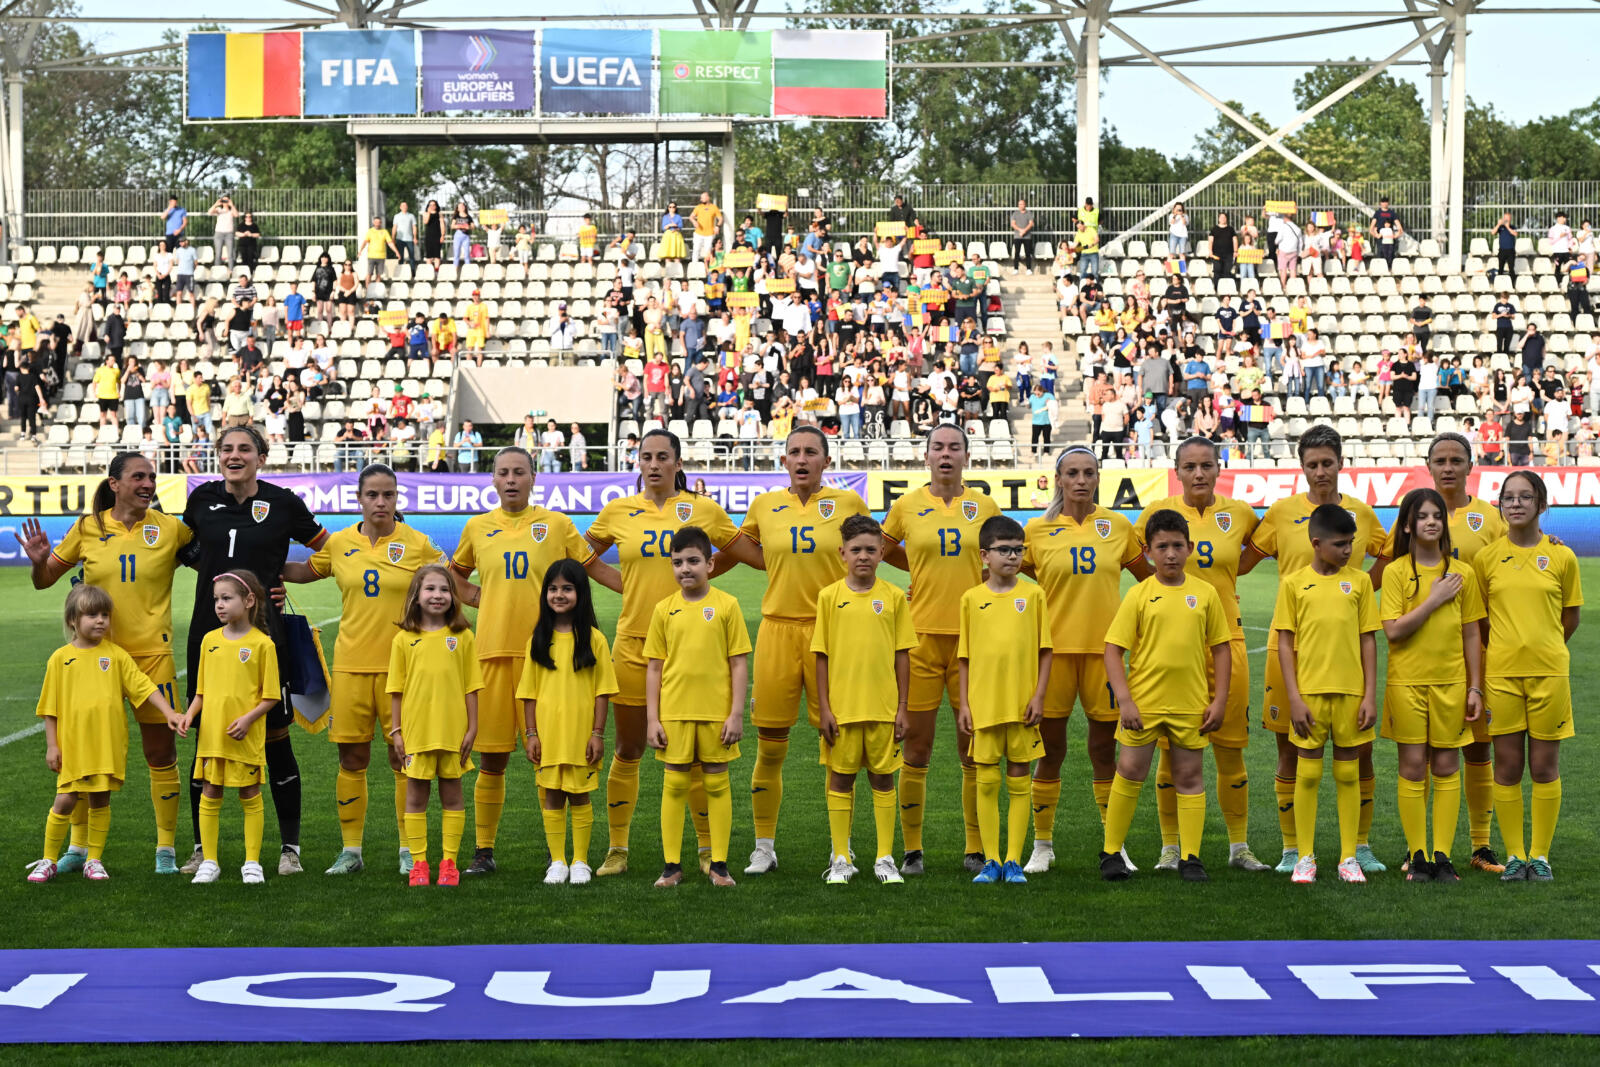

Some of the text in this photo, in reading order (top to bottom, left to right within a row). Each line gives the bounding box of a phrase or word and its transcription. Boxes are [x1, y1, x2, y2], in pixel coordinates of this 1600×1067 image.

[321, 58, 399, 86] FIFA
[550, 56, 641, 86] UEFA
[695, 65, 761, 80] RESPECT
[442, 91, 515, 103] QUALIFIERS
[443, 81, 513, 92] EUROPEAN
[417, 485, 592, 511] EUROEAN
[227, 528, 238, 558] 1
[640, 530, 674, 557] 20
[790, 526, 816, 553] 15
[937, 528, 961, 557] 13
[118, 554, 136, 582] 11
[503, 551, 529, 579] 10
[1069, 546, 1097, 575] 19
[1197, 541, 1214, 569] 9
[363, 569, 380, 598] 8
[187, 963, 1600, 1012] QUALIFI
